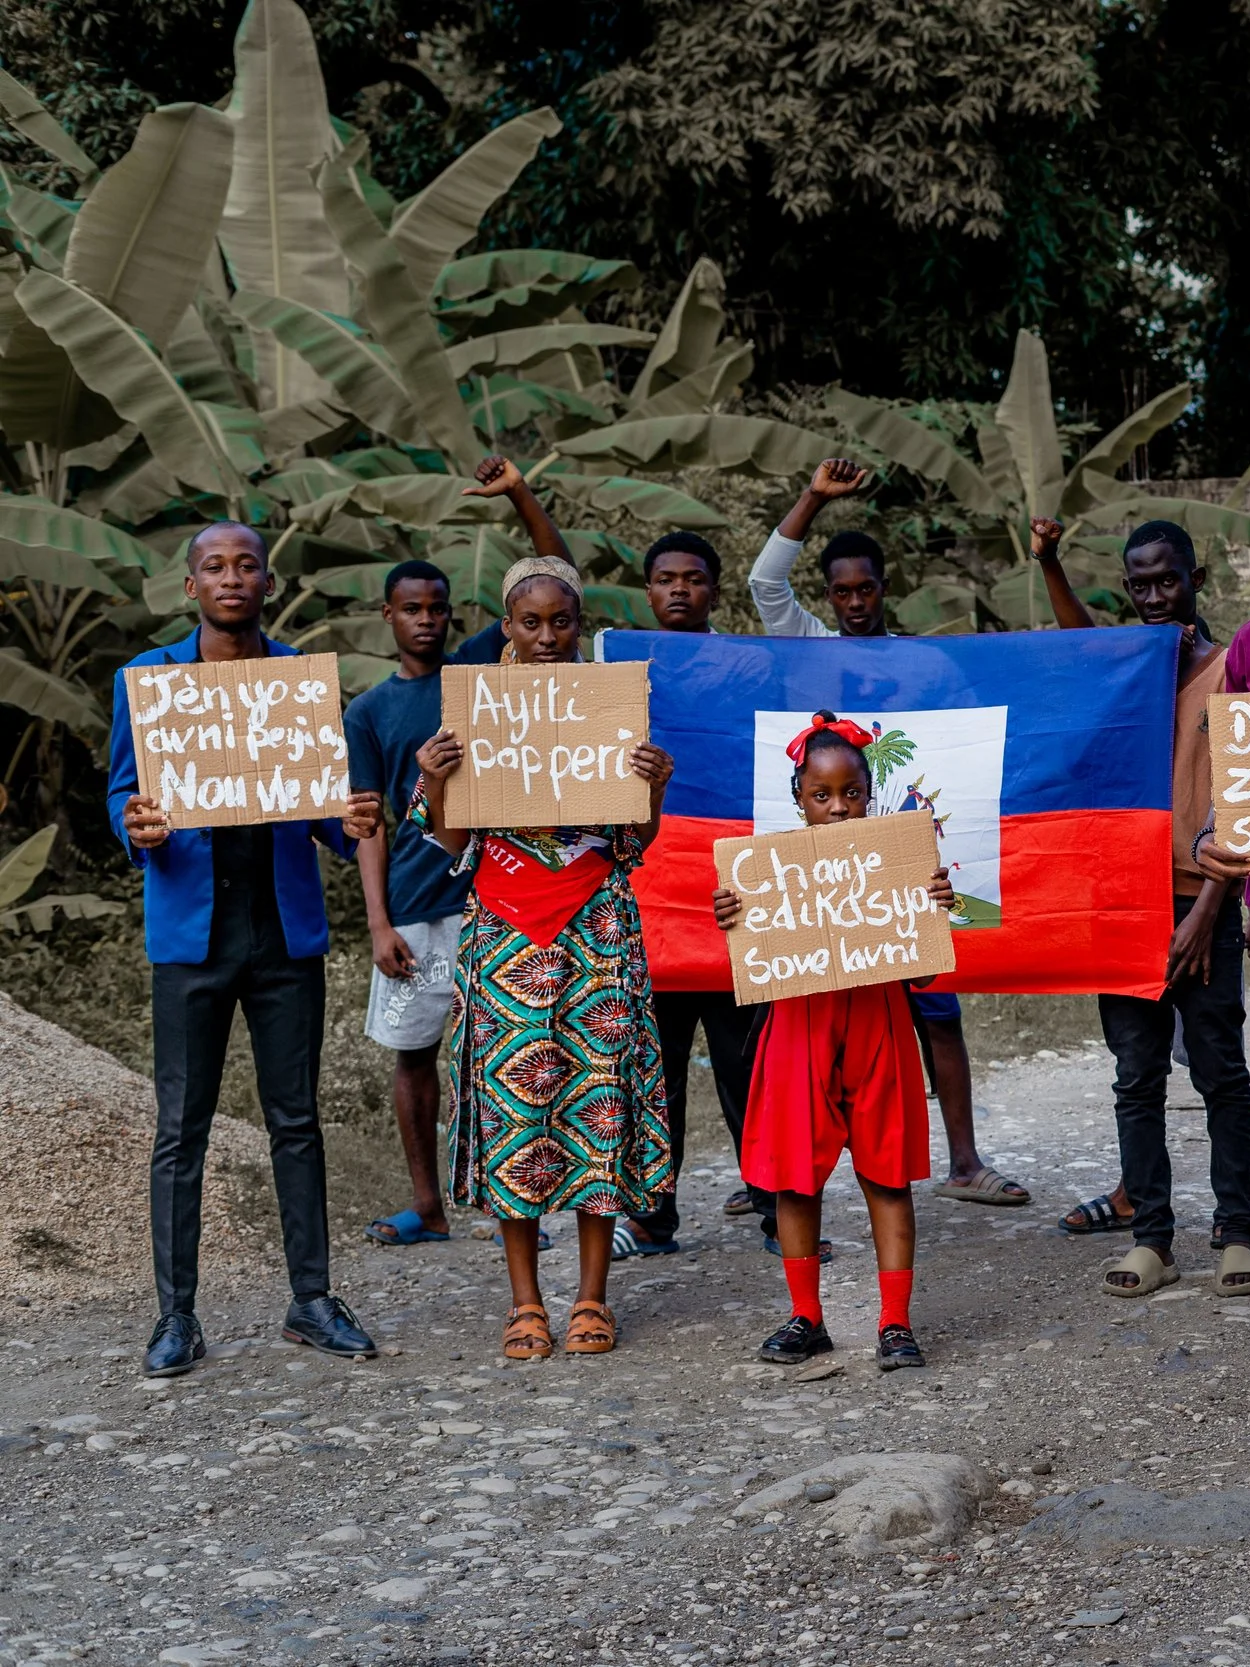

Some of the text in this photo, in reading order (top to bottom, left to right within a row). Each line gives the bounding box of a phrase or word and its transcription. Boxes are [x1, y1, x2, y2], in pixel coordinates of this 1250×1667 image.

[238, 679, 288, 726] yo
[472, 672, 586, 745] Ayiti
[145, 712, 236, 753] avni
[160, 760, 247, 812] Nou
[732, 843, 884, 900] Chanje
